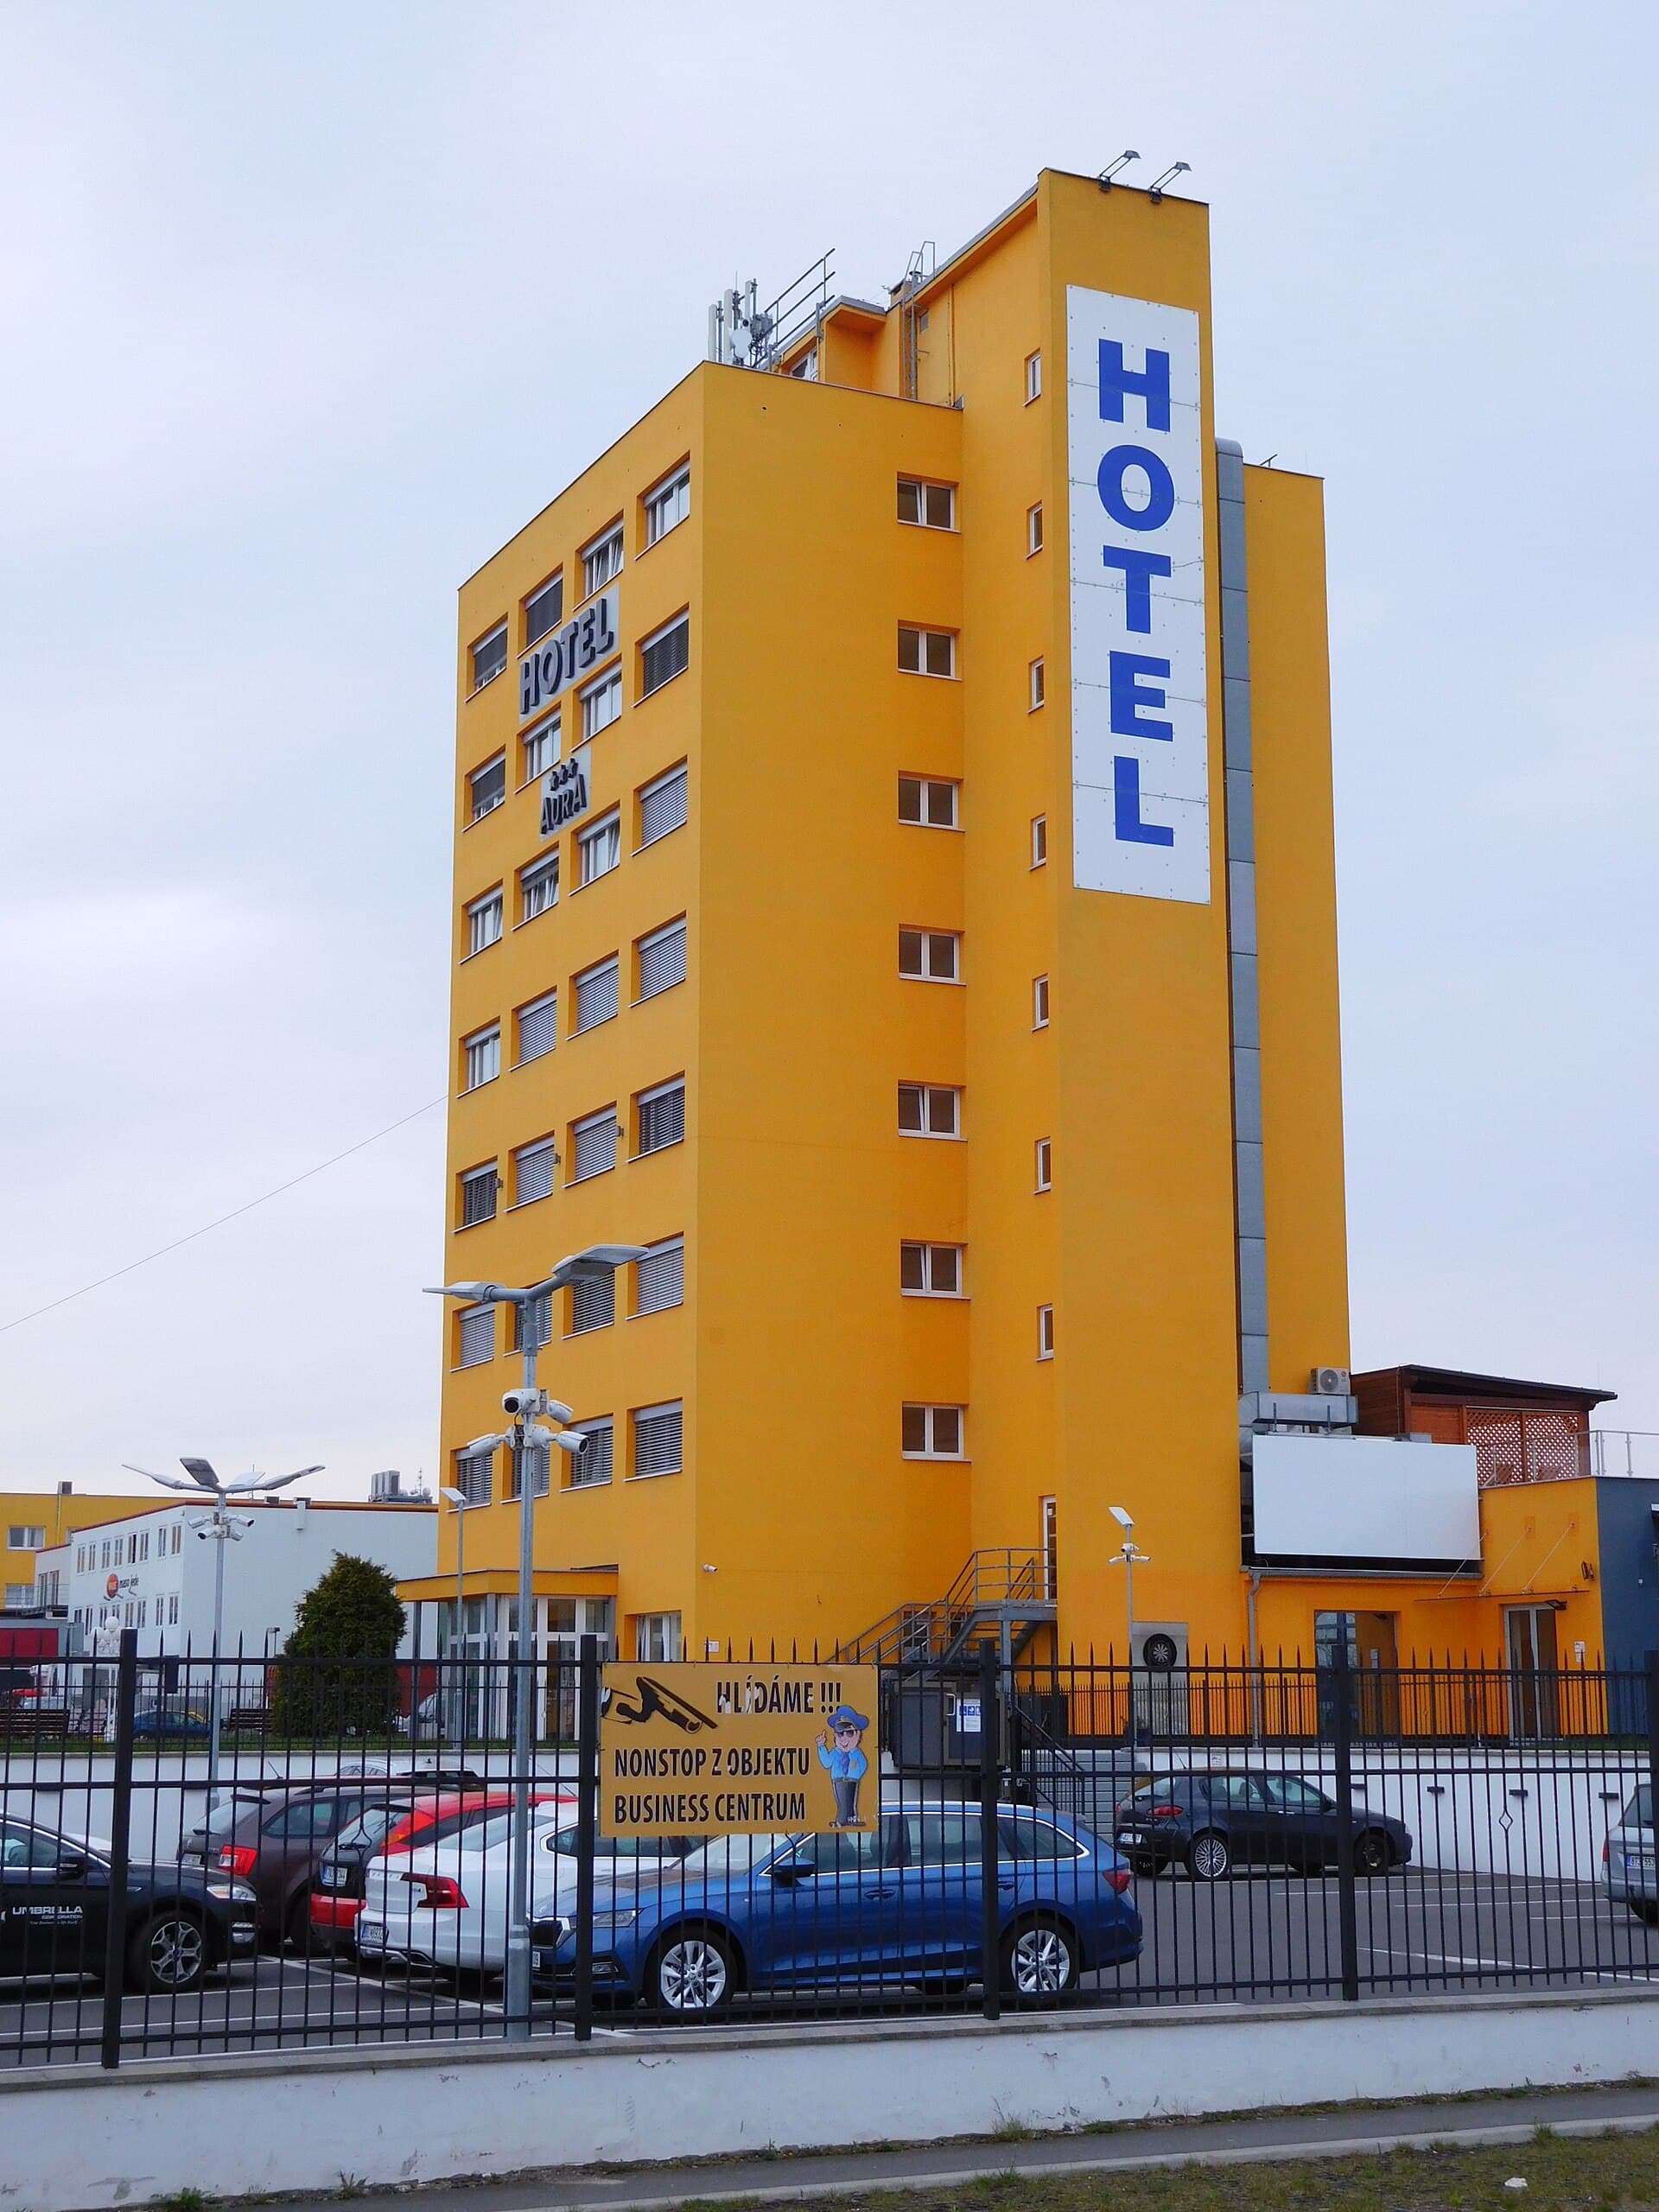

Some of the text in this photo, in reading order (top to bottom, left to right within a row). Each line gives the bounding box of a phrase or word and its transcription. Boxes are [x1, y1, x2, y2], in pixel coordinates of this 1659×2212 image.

[1097, 338, 1175, 848] HOTEL
[520, 598, 613, 715] HOTEL
[541, 774, 588, 834] AURA
[717, 1675, 814, 1713] HLÍDÁME
[614, 1747, 810, 1777] NONSTOP Z OBJEKTU
[614, 1793, 805, 1823] BUSINESS CENTRUM
